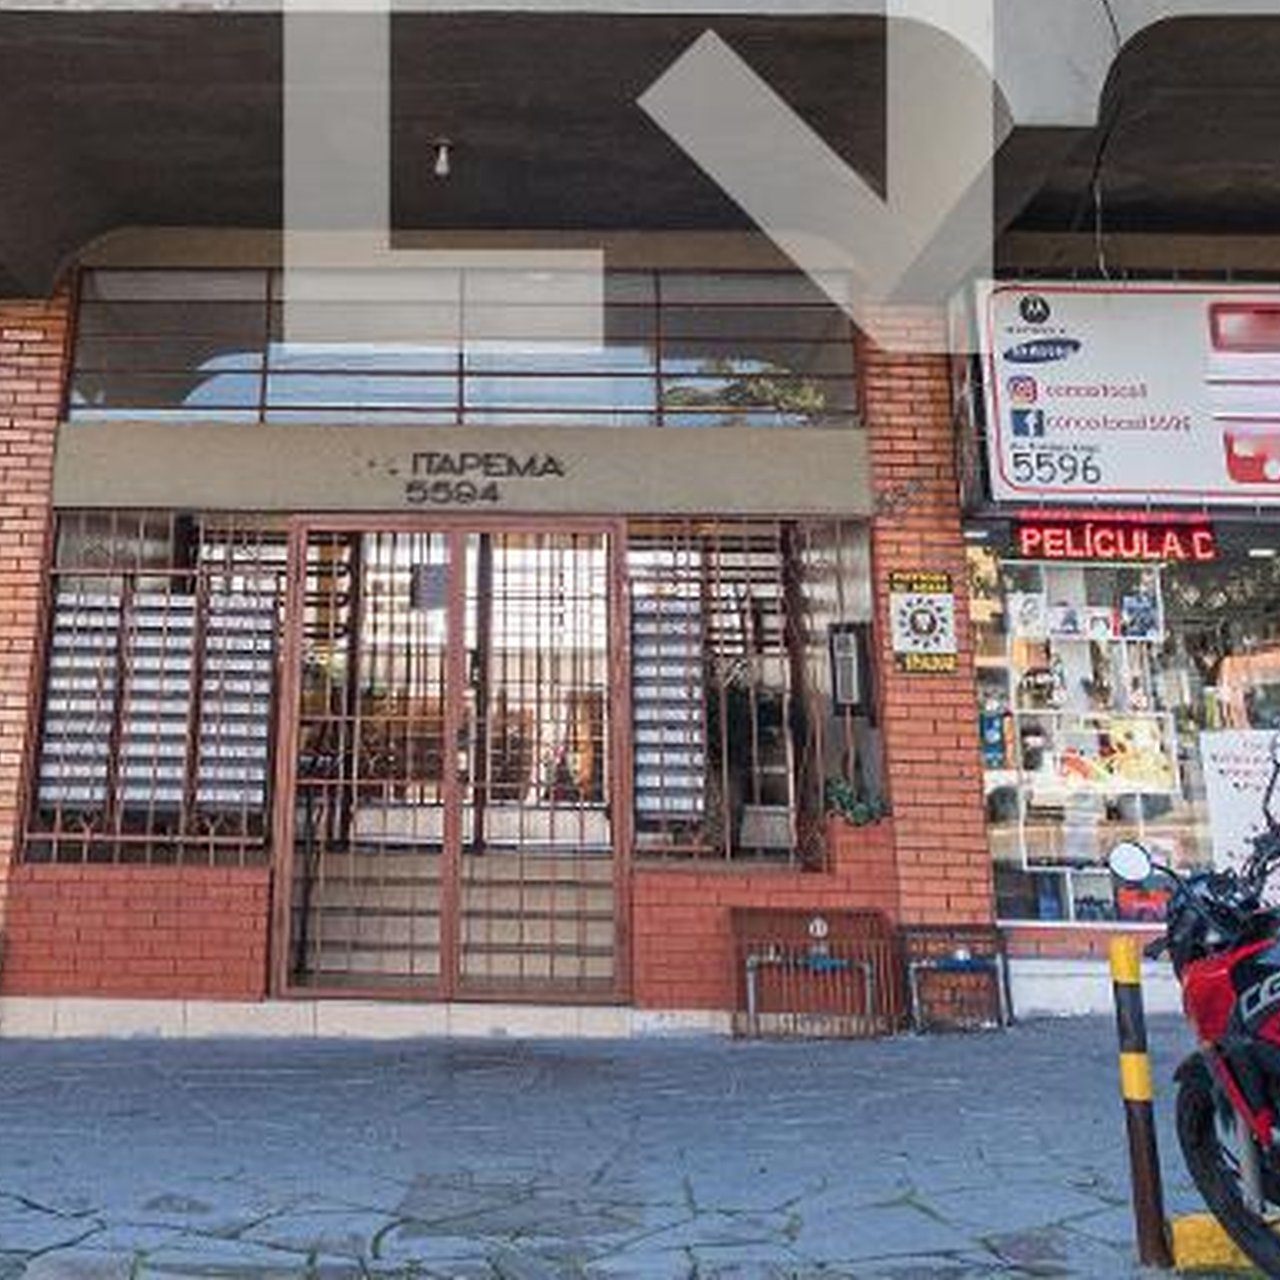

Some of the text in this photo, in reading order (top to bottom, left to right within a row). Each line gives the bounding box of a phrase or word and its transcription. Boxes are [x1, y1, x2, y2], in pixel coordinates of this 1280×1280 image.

[411, 452, 566, 477] ITAPEMA
[1013, 453, 1101, 484] 5596
[405, 479, 501, 504] 5594
[1020, 522, 1185, 559] PELÍCULA
